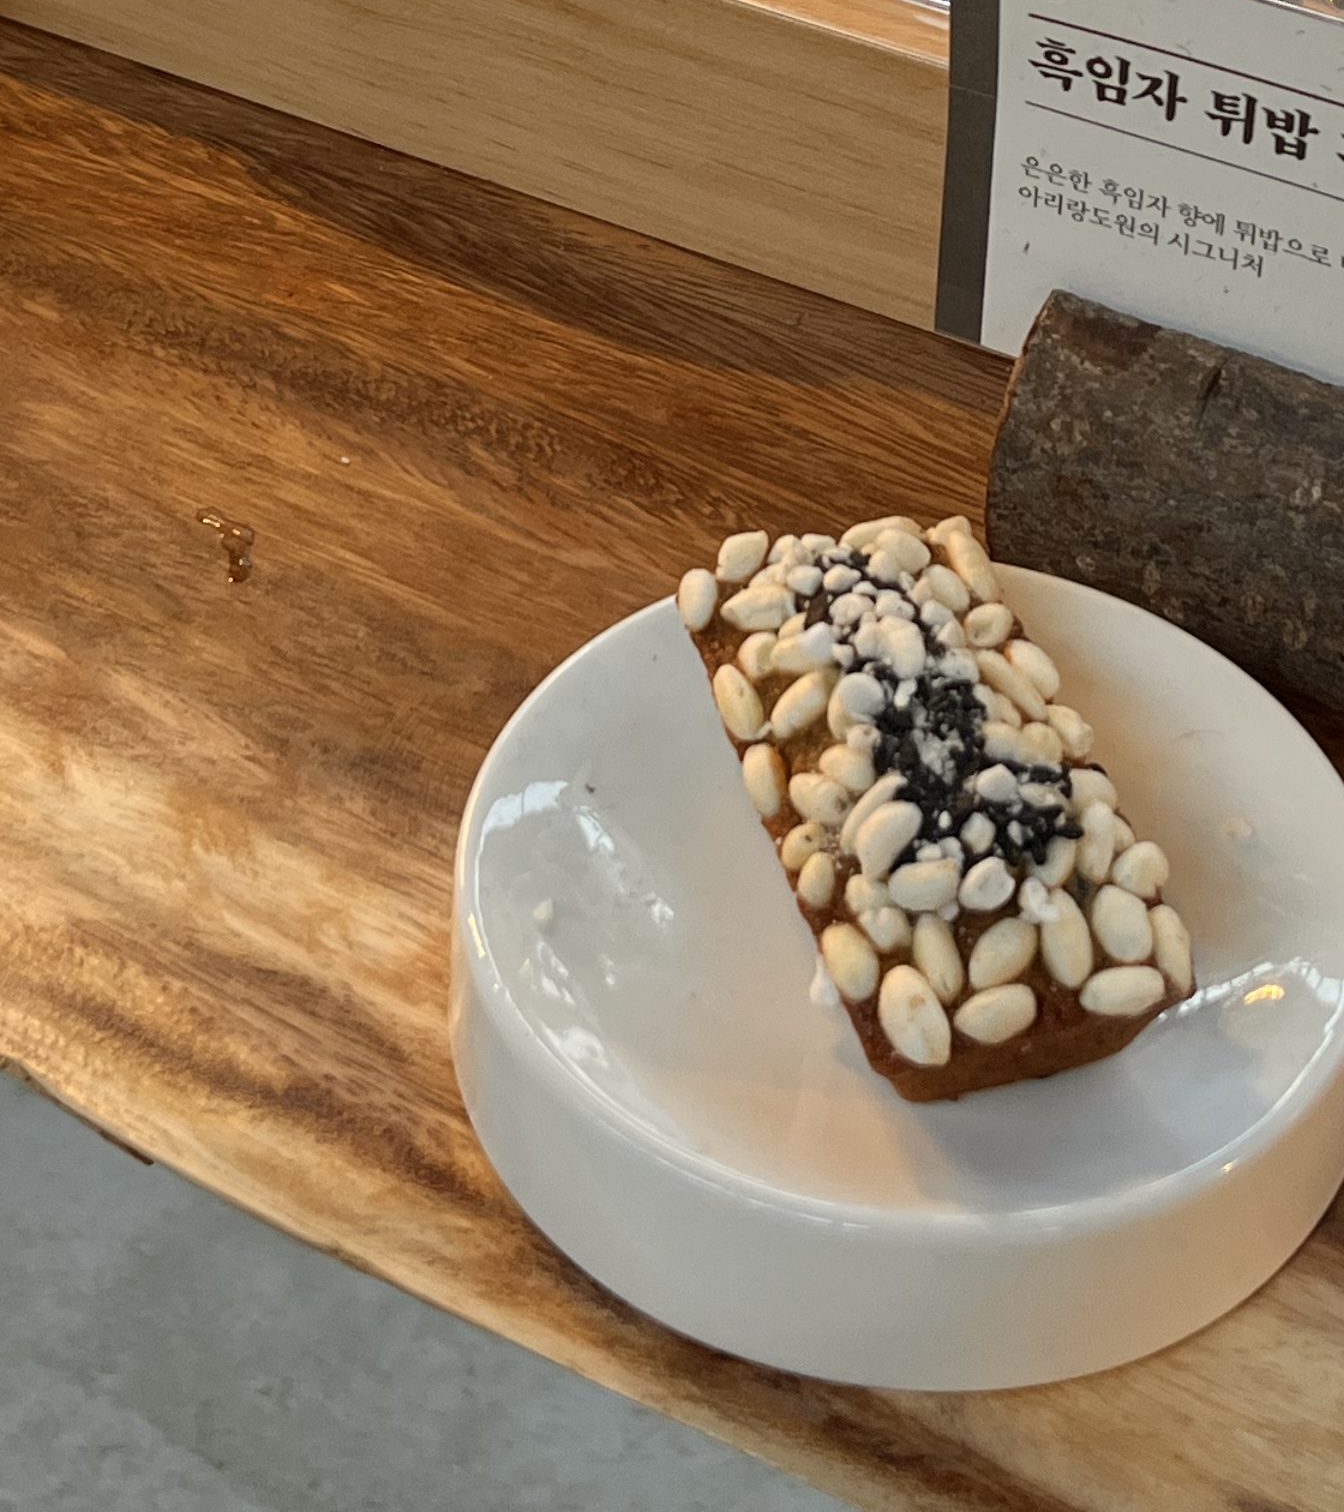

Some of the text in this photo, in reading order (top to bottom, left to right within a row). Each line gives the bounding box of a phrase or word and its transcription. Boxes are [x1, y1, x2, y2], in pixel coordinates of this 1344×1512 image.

[1028, 37, 1188, 122] 흑임자
[1205, 90, 1319, 161] 튀밥
[1018, 185, 1264, 278] 아리랑도원의 시그니처
[1021, 156, 1093, 194] 은은한
[1098, 178, 1171, 218] 흑임자
[1178, 202, 1226, 236] 향에
[1233, 220, 1332, 268] 튀밥으로
